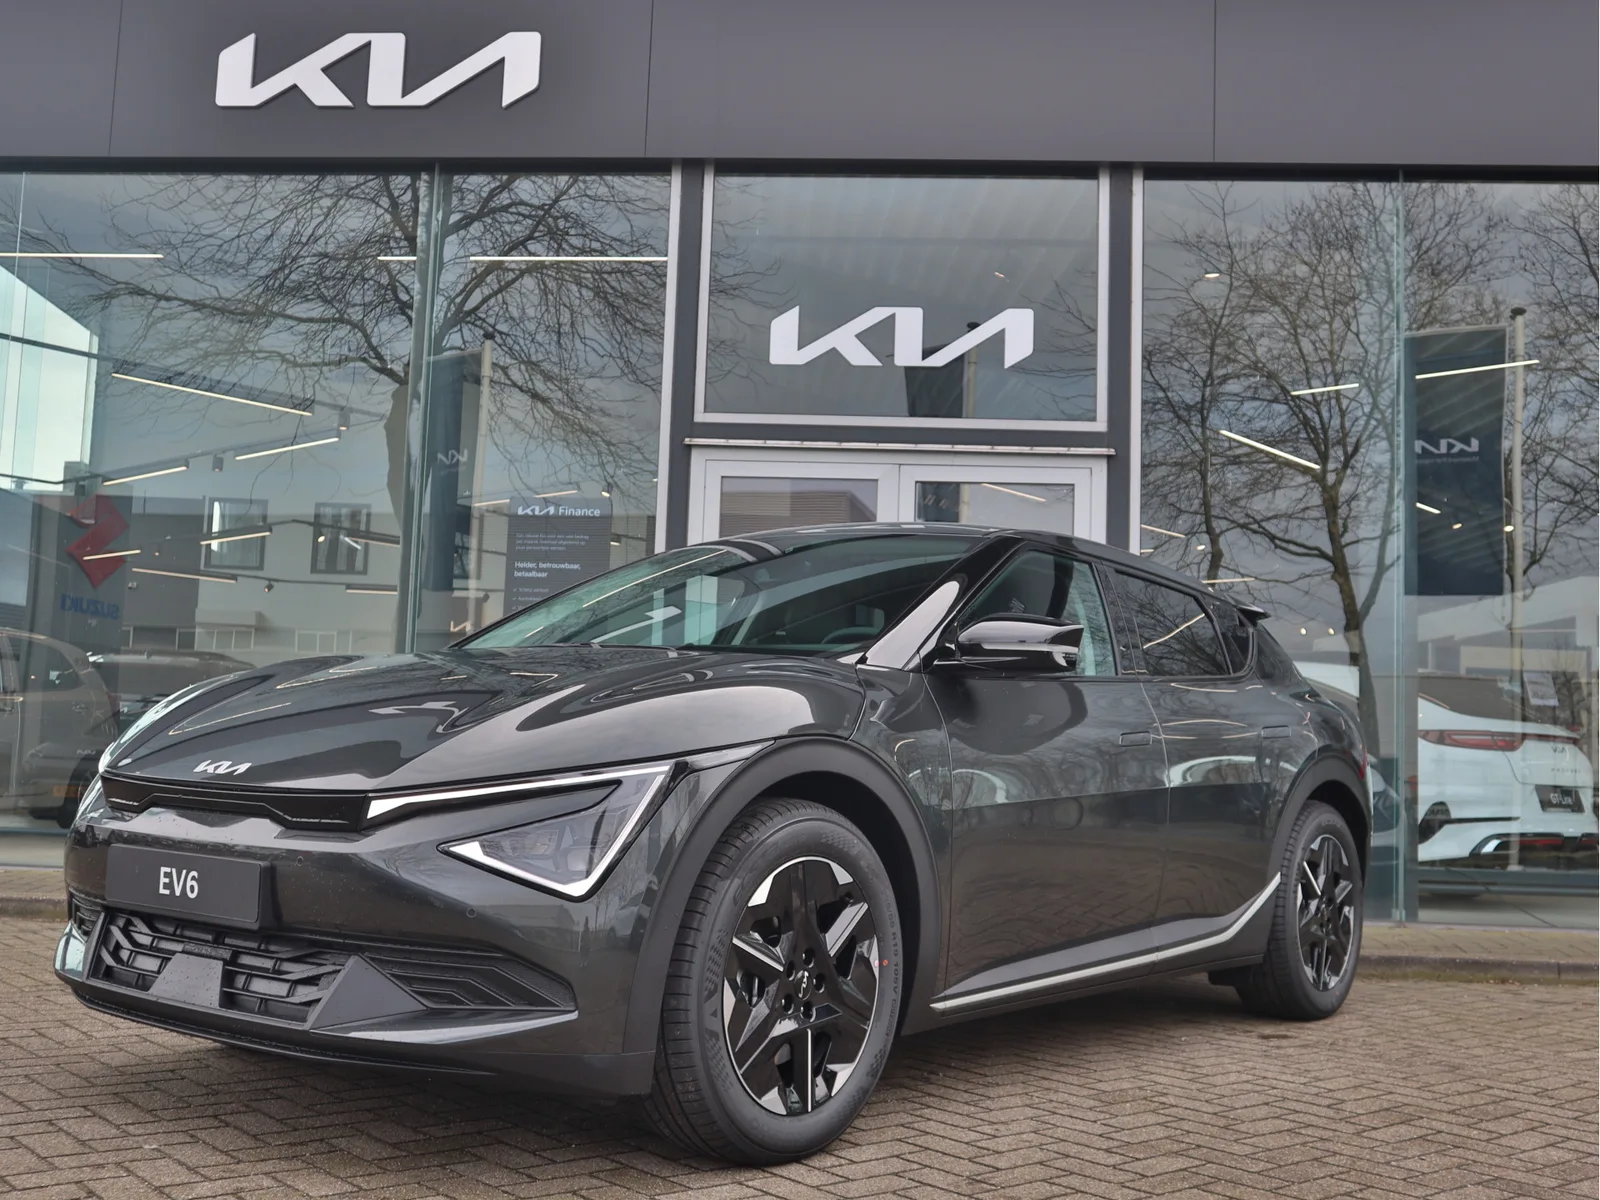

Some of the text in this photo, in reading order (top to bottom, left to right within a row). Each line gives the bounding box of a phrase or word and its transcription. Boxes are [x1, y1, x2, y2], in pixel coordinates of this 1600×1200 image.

[215, 31, 542, 108] KIA
[769, 305, 1035, 369] KIA
[517, 505, 601, 517] KIA Finance
[513, 570, 549, 578] betaalbaar
[514, 561, 581, 571] Helder, betrouwbaar,
[192, 759, 252, 776] KIA
[158, 866, 199, 900] EV6
